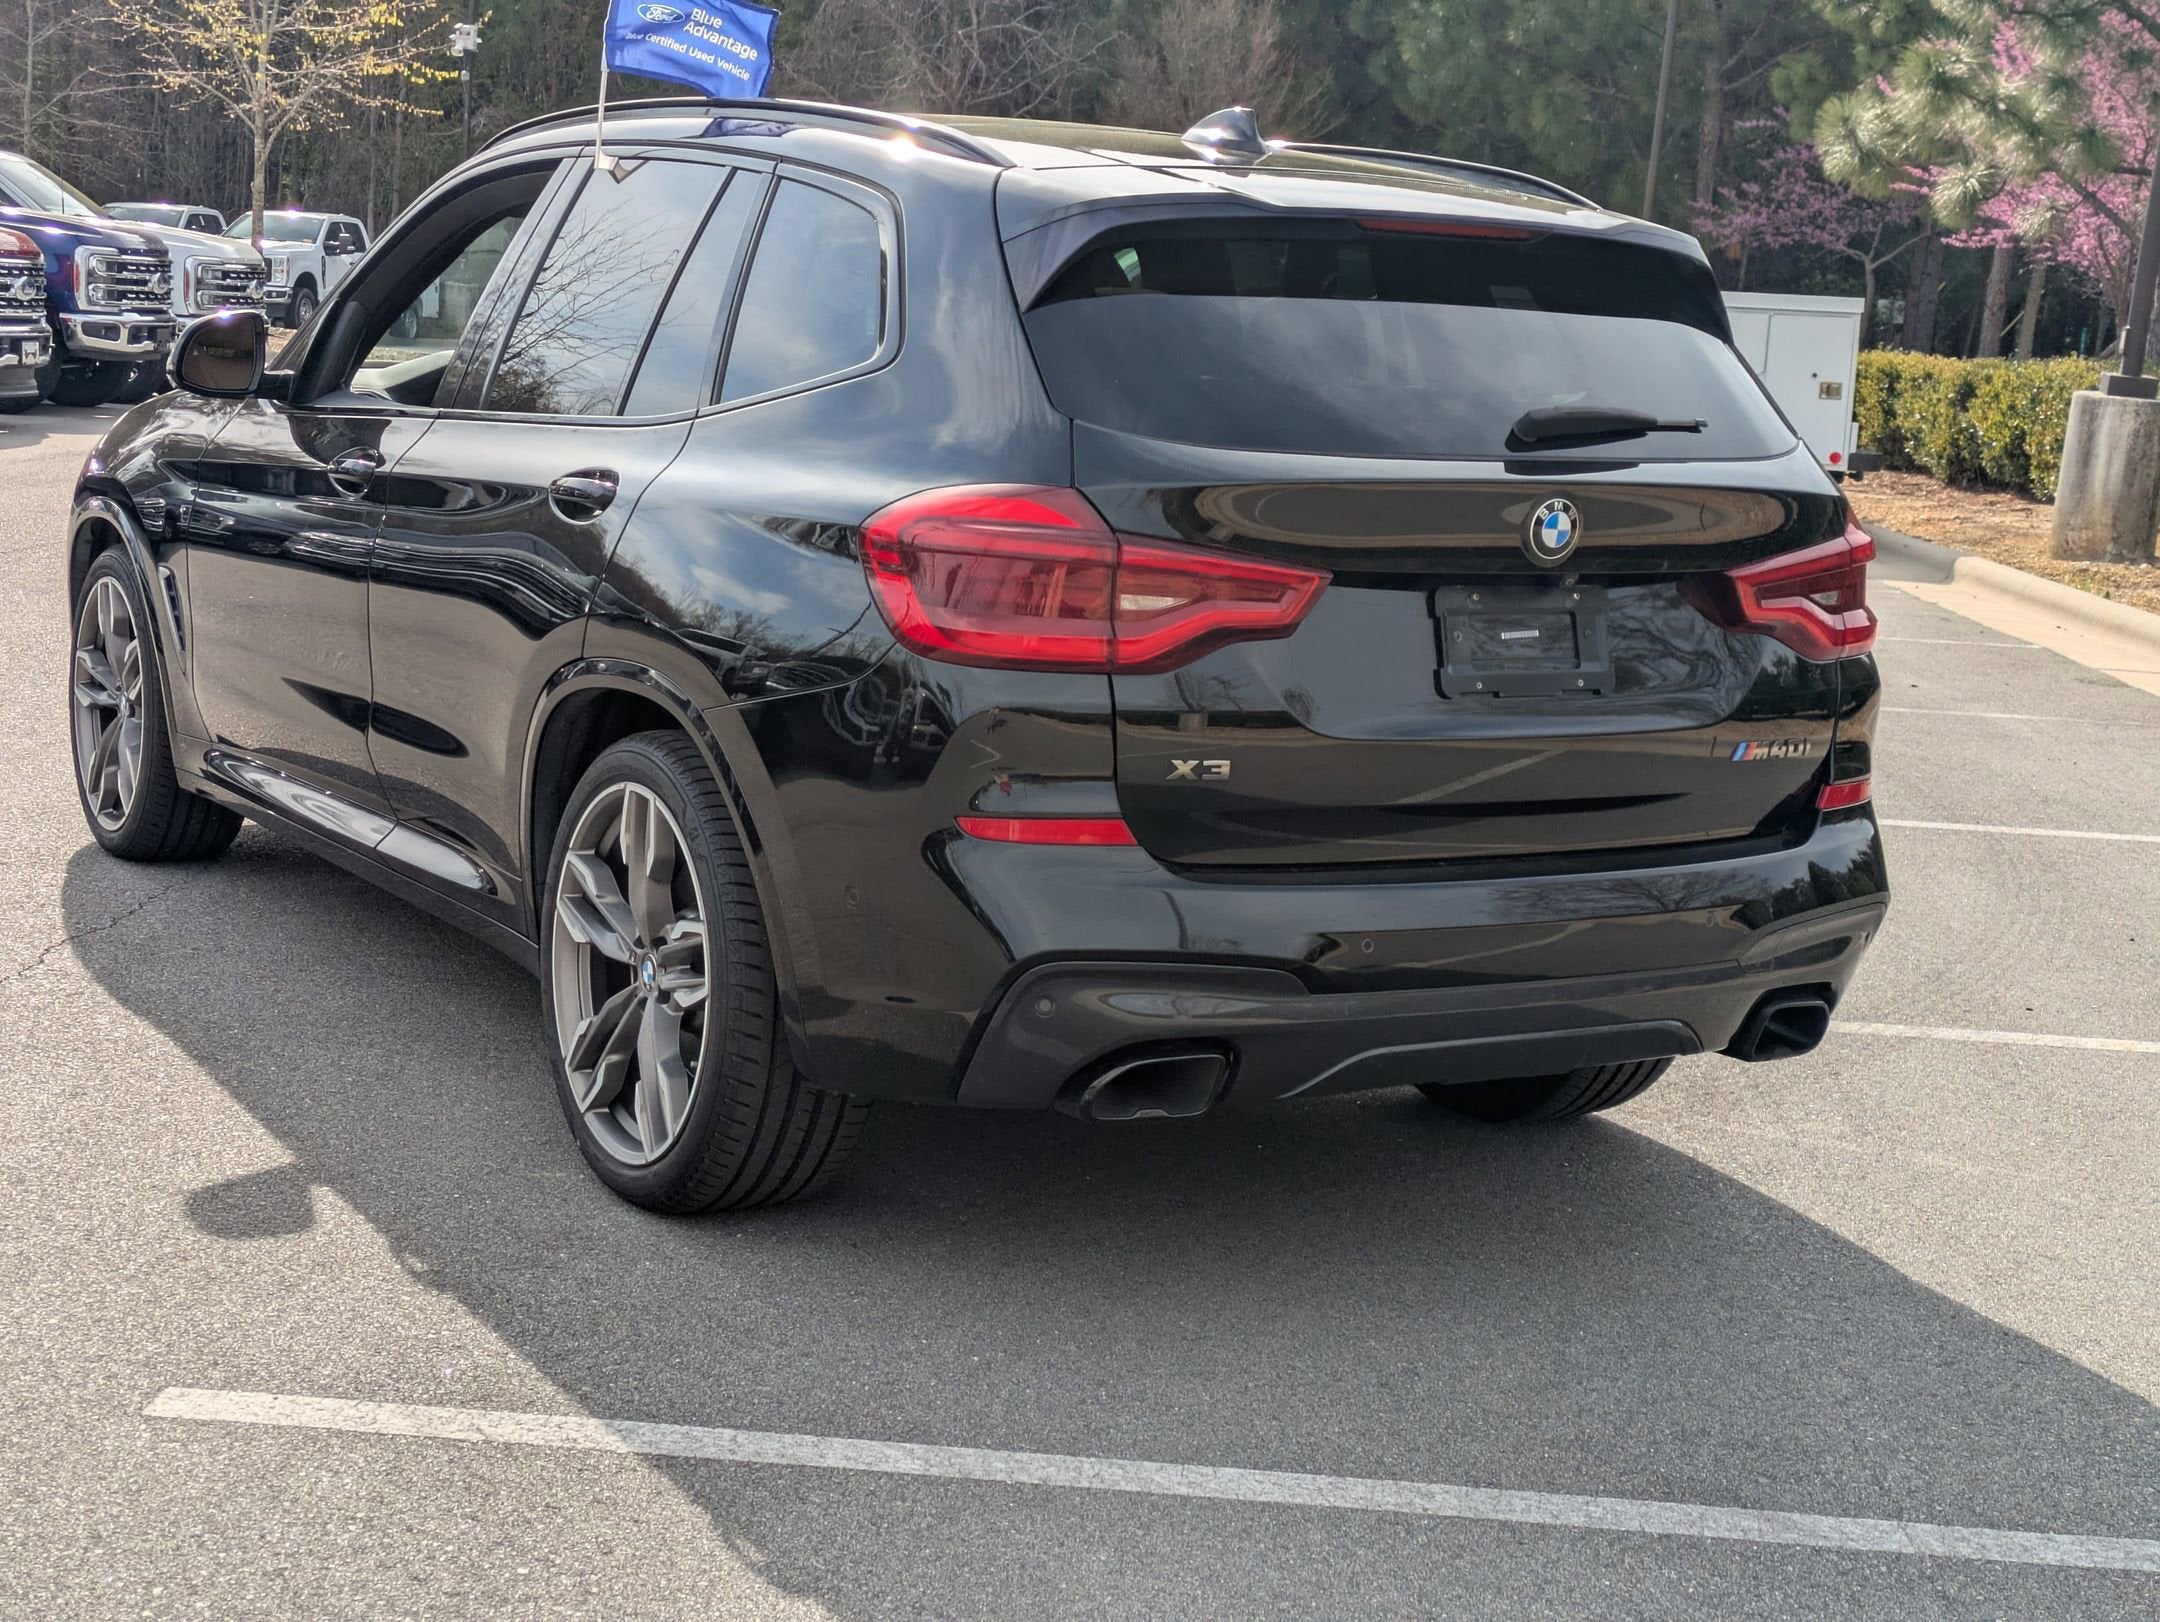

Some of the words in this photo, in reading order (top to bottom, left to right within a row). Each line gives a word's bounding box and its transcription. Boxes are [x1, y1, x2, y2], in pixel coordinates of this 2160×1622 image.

[646, 6, 678, 21] Ford
[690, 8, 723, 29] Blue
[683, 21, 758, 61] Advantage
[645, 33, 688, 53] Certified
[689, 46, 715, 64] Used
[717, 56, 750, 81] Vehicle
[1538, 501, 1577, 520] BMW
[1165, 759, 1231, 780] X3
